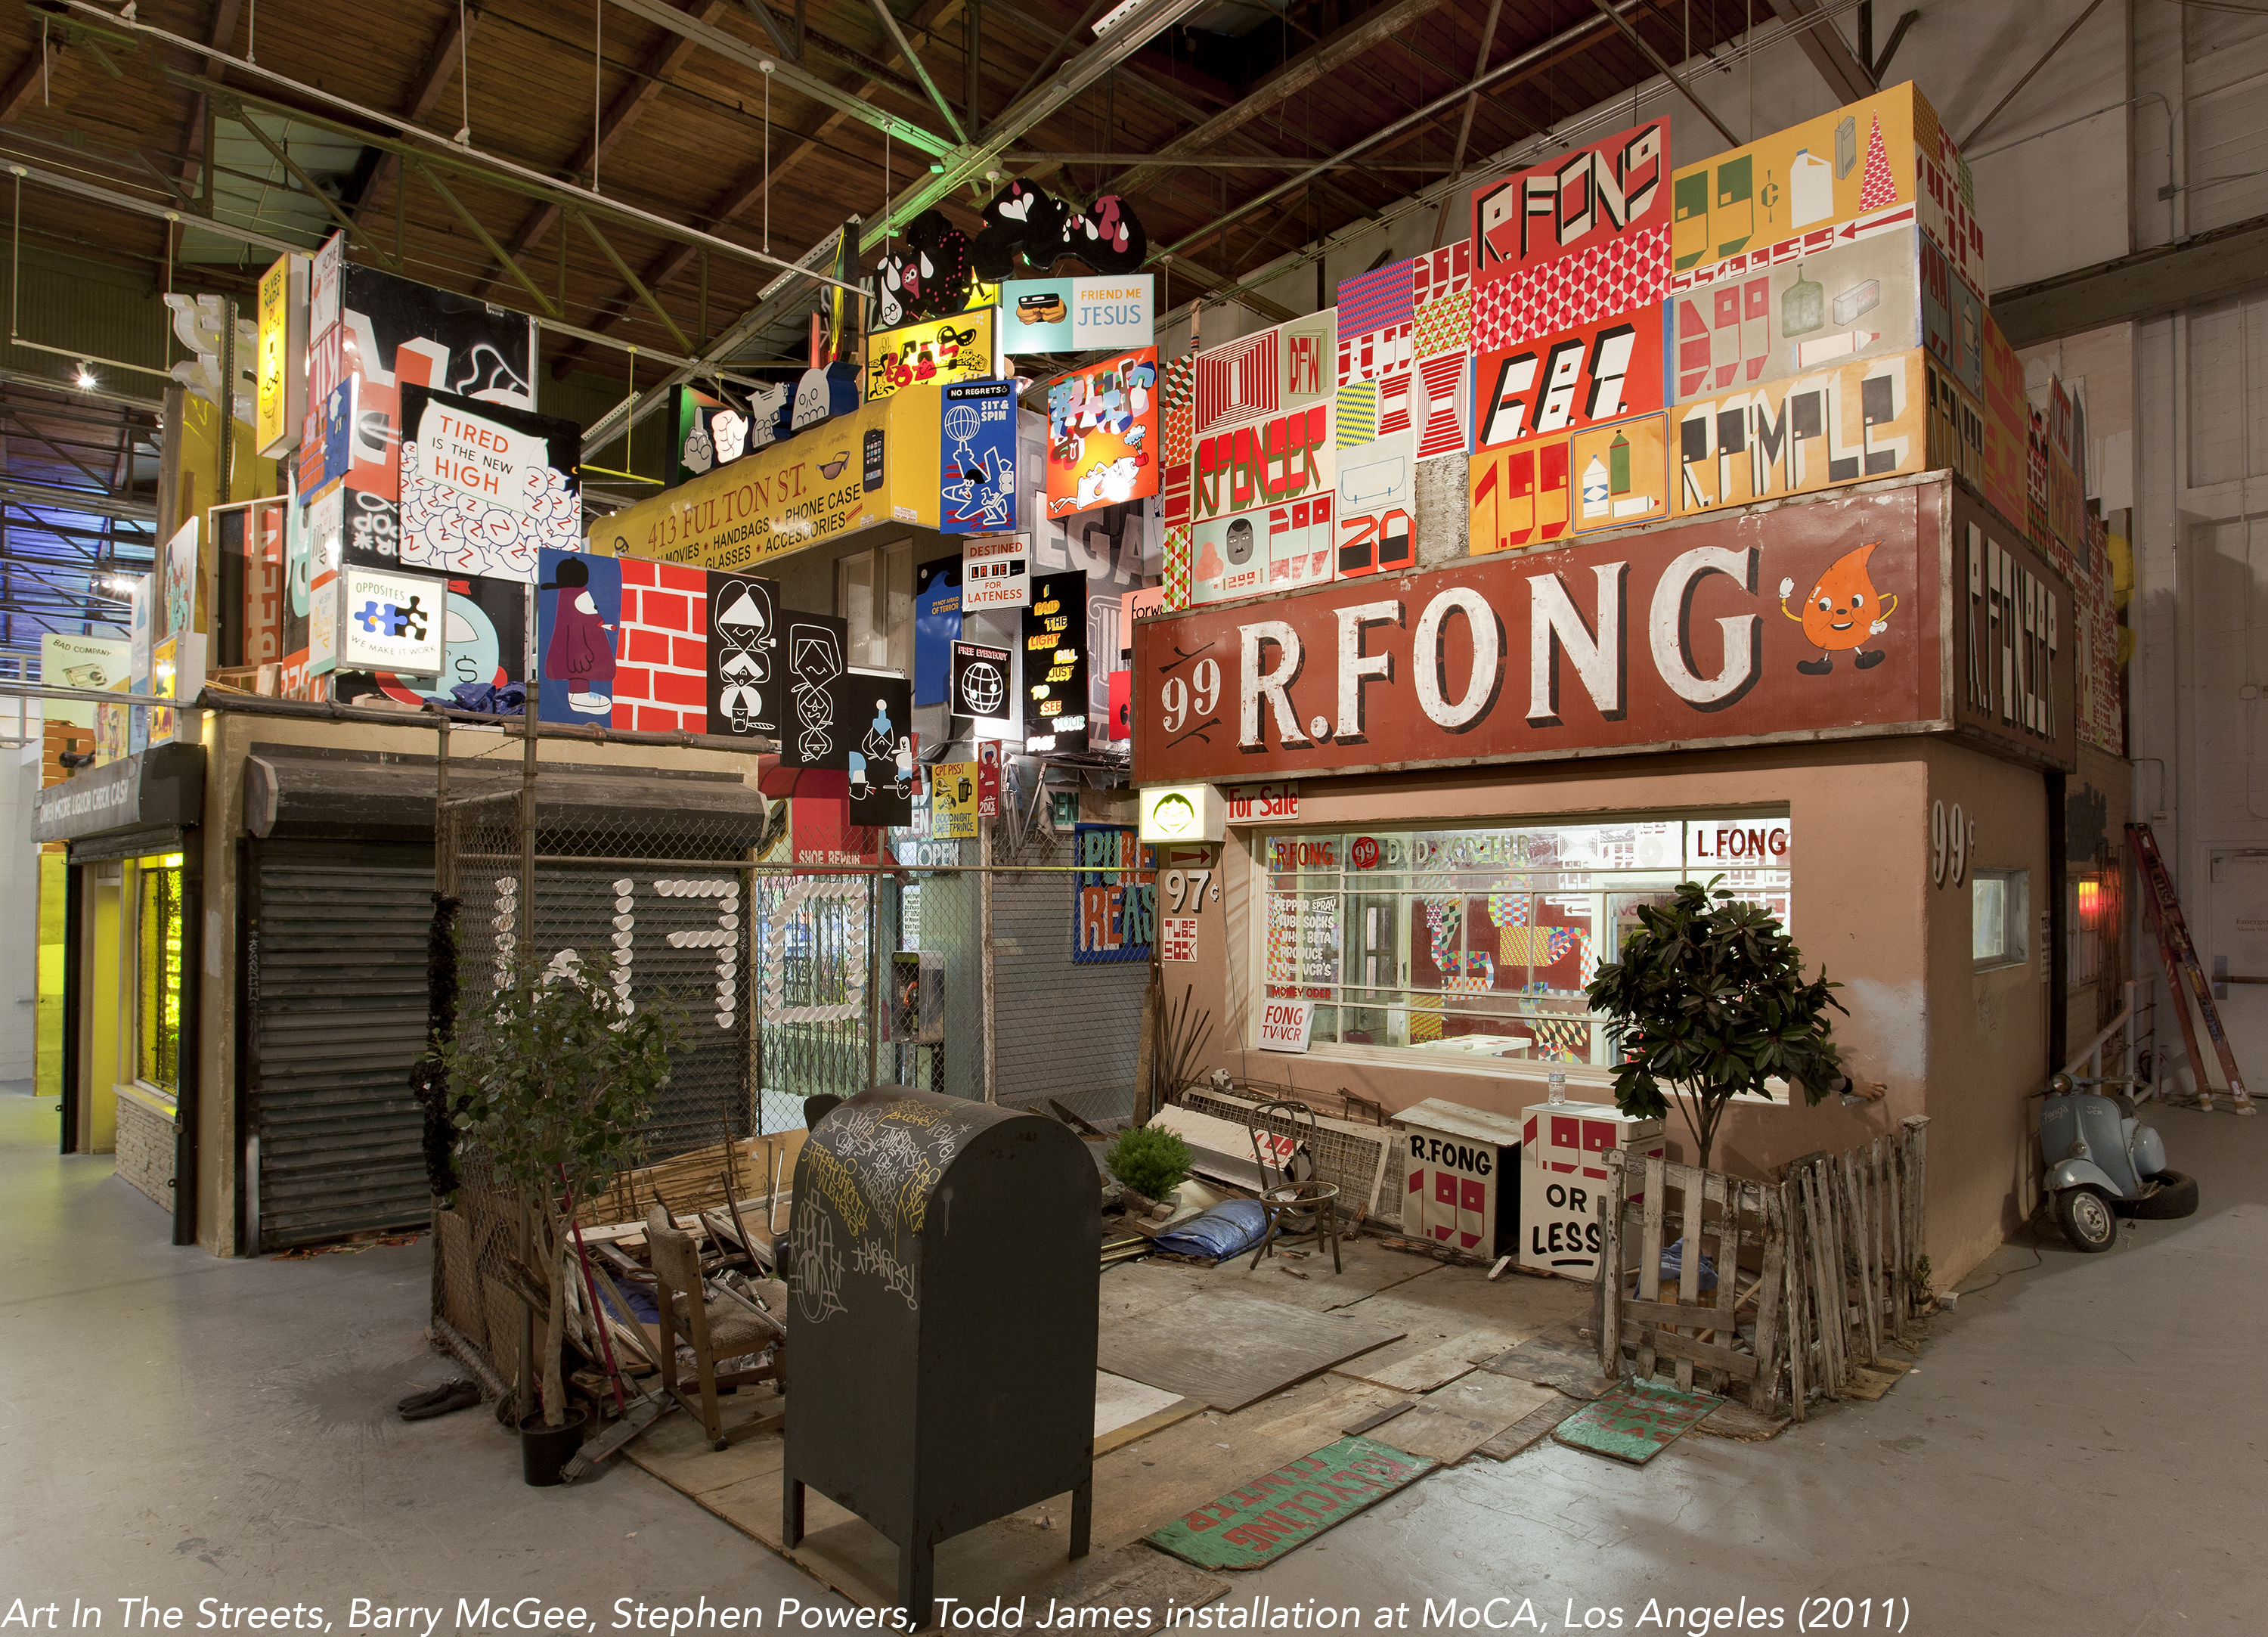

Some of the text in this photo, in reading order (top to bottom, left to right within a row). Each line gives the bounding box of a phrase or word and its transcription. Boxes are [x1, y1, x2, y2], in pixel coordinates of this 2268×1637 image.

[271, 269, 281, 288] VES
[264, 287, 280, 310] NADA
[1081, 287, 1142, 301] FRIEND ME
[269, 305, 275, 321] DI
[1078, 304, 1142, 327] JESUS
[265, 315, 280, 338] NADA
[951, 386, 1002, 397] NO REGRETS
[981, 411, 1007, 422] SPIN
[440, 415, 509, 454] TIRED
[432, 437, 513, 475] IS THE NEW
[435, 456, 499, 495] HIGH
[648, 462, 807, 552] 413 FULTON ST.
[665, 482, 861, 563] MOVIES HANDBAGS PHONE CASE
[765, 511, 846, 554] ACCESSORIES
[970, 542, 1023, 557] DESTINED
[356, 582, 404, 601] OPPOSITES
[984, 581, 1002, 589] FOR
[947, 596, 959, 604] AFRAID
[968, 588, 1023, 603] LATENESS
[940, 602, 959, 613] TERROR
[1034, 600, 1060, 615] PAID
[1045, 616, 1067, 631] THE
[53, 639, 113, 657] BAD COMPANY
[352, 635, 366, 648] WE
[368, 644, 395, 656] MAKE
[410, 645, 436, 656] WORK
[1028, 634, 1060, 650] LIGHT
[1161, 545, 1760, 753] 99 R.FONG
[958, 646, 1009, 662] FREE EVERYBODY
[1054, 648, 1078, 665] BILL
[1046, 666, 1074, 681] JUST
[1030, 684, 1050, 700] TO
[1040, 700, 1062, 716] SEE
[1052, 715, 1086, 733] YOUR
[1027, 735, 1056, 752] FACE
[948, 763, 965, 775] PISSY
[40, 779, 129, 823] OWEN MOORE LIQUOR CHECK CASH
[1228, 785, 1298, 819] For Sale
[935, 812, 972, 824] GOODNIGHT
[1698, 827, 1786, 857] L.FONG
[798, 849, 860, 865] SHOE REPAIR
[918, 842, 959, 867] OPEN
[1277, 842, 1334, 867] R.FONG
[1356, 842, 1376, 863] 99
[1274, 898, 1337, 913] PEPPER SPRAY
[1164, 919, 1196, 938] TUBE
[1278, 915, 1334, 929] TUBE SOCKS
[1282, 932, 1301, 943] VHS
[1307, 932, 1331, 944] BETA
[1280, 947, 1323, 960] PRODUCE
[1275, 963, 1287, 975] TV
[1302, 963, 1331, 977] VCR'S
[1272, 987, 1331, 999] MONEY ODER
[1265, 1005, 1303, 1026] FONG
[1410, 1135, 1492, 1176] R.FONG
[1523, 1114, 1616, 1180] 1.99
[1545, 1184, 1587, 1214] OR
[1409, 1168, 1486, 1249] 1.99
[1532, 1222, 1600, 1256] LESS
